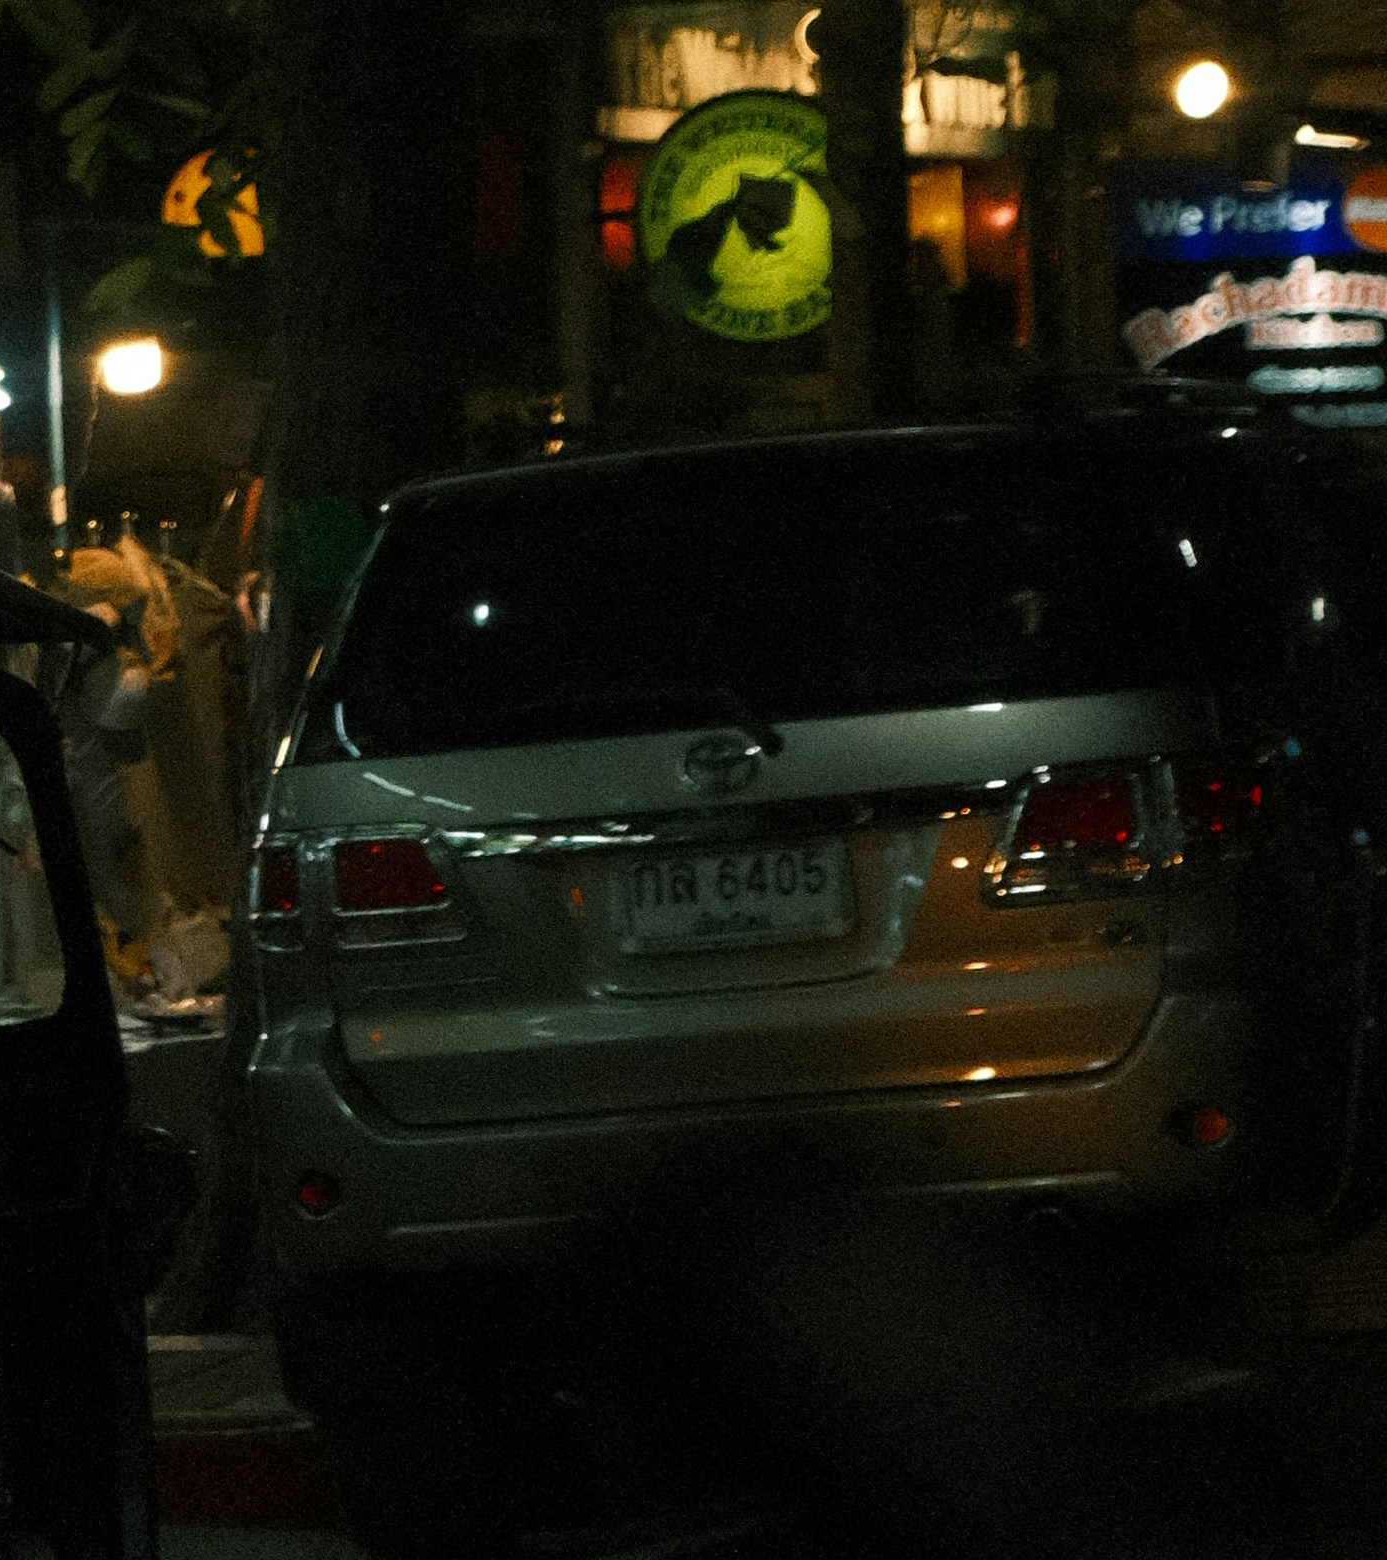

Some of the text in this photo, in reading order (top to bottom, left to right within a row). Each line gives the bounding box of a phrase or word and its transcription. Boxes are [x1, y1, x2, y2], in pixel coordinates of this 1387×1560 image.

[1135, 197, 1204, 238] We
[1208, 191, 1332, 235] Prefer
[717, 850, 827, 901] 6405
